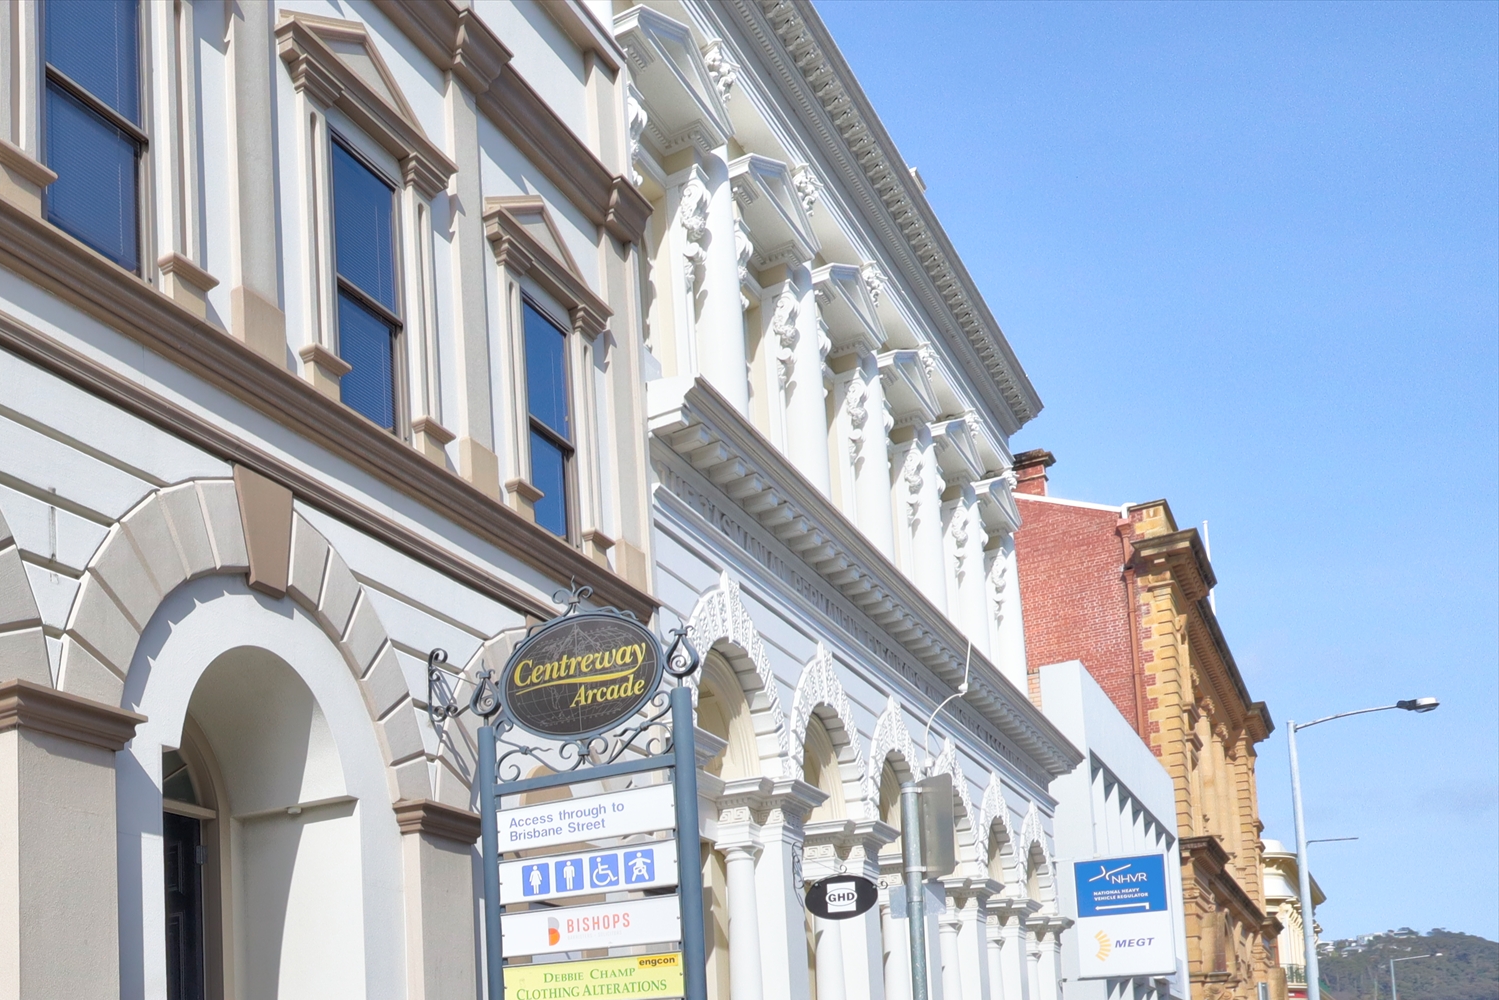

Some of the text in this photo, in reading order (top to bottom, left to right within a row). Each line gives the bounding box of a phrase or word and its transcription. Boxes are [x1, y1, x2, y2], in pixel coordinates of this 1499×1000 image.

[698, 494, 786, 581] TASMANIAN
[791, 570, 863, 637] PERMANENT
[514, 642, 646, 690] Centreway
[570, 674, 645, 708] Arcade
[509, 802, 625, 829] Access through to
[510, 818, 606, 842] Brisbane Street
[1111, 872, 1147, 884] NHVR
[828, 892, 855, 902] GHD
[567, 912, 630, 934] BISHOPS
[1115, 937, 1155, 948] MEGT
[639, 957, 676, 967] engcon
[543, 967, 636, 984] DEBBIE CHAMP
[517, 979, 667, 1000] CLOTHING ALTERATIONS
